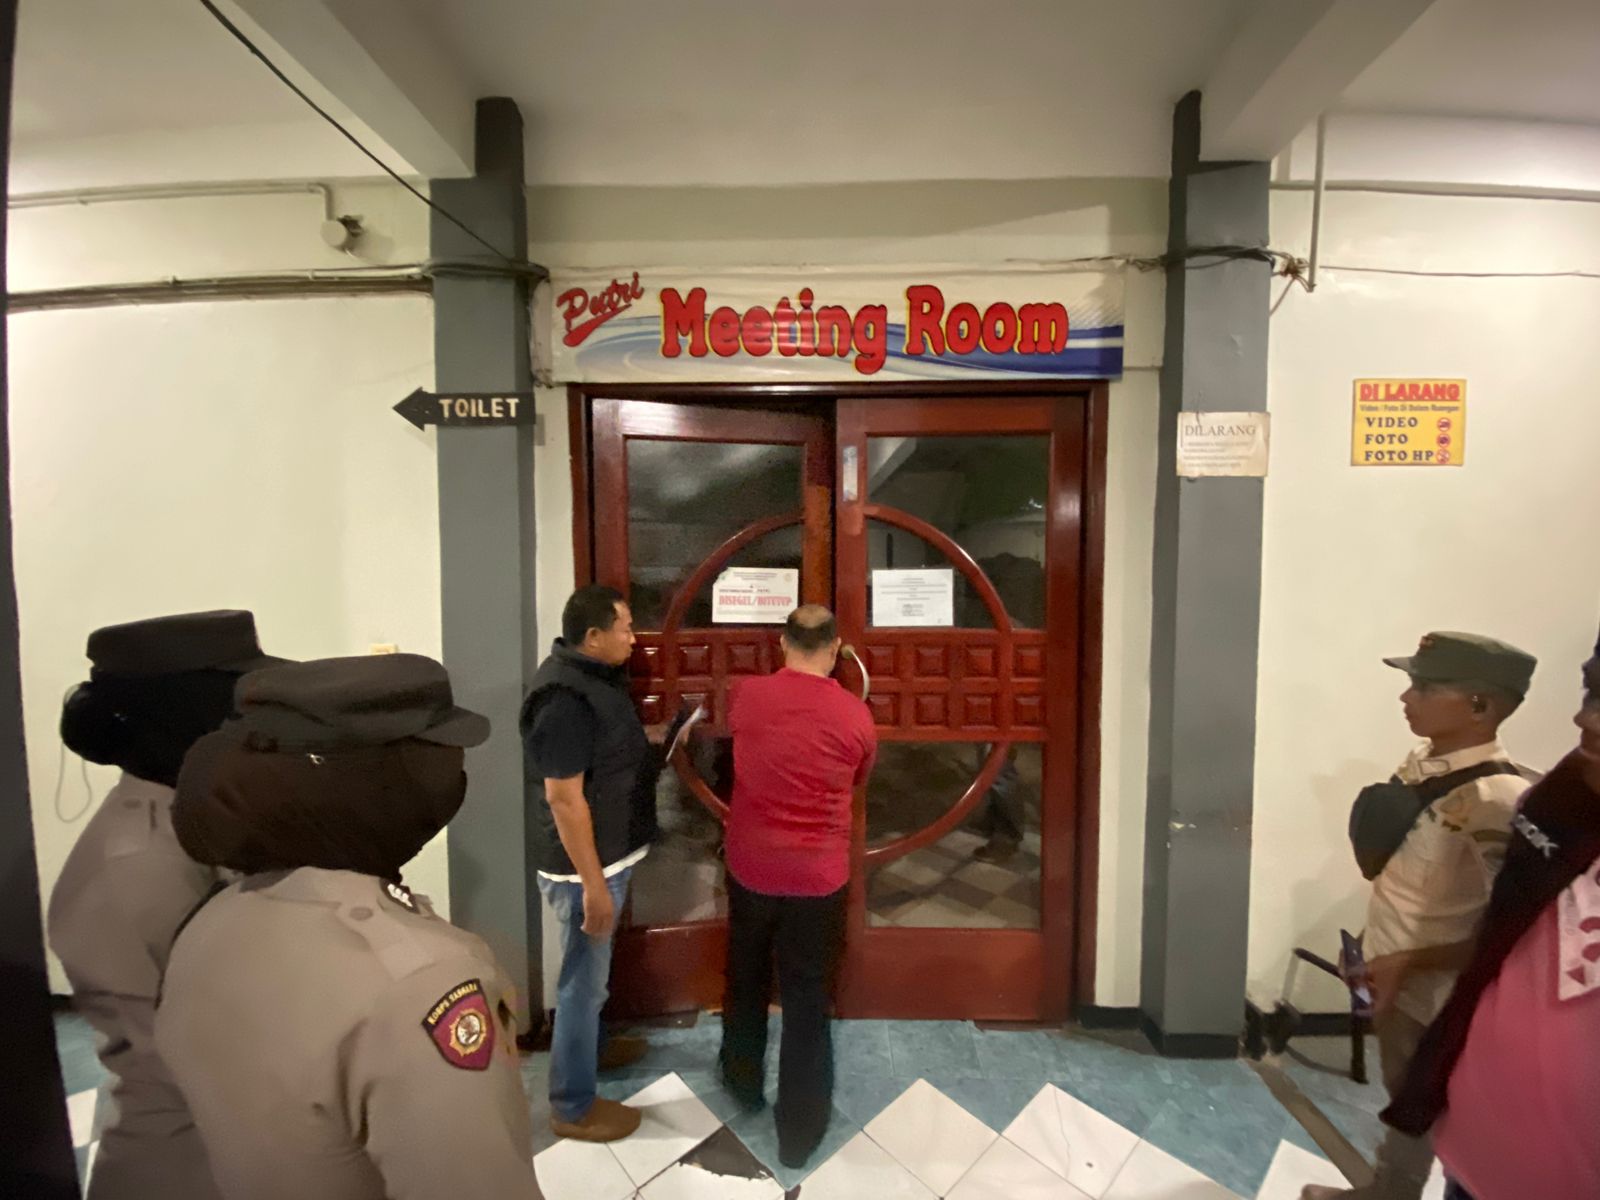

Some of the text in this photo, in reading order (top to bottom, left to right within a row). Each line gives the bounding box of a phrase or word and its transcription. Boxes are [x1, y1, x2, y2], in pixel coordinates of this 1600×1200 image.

[556, 271, 1069, 375] Putri Meeting Room
[1361, 383, 1459, 401] DI LARANG
[438, 398, 521, 418] TOILET
[1365, 417, 1418, 428] VIDEO
[1185, 425, 1256, 436] DILARANG
[1365, 434, 1408, 445] FOTO
[1365, 450, 1434, 461] FOTO HP
